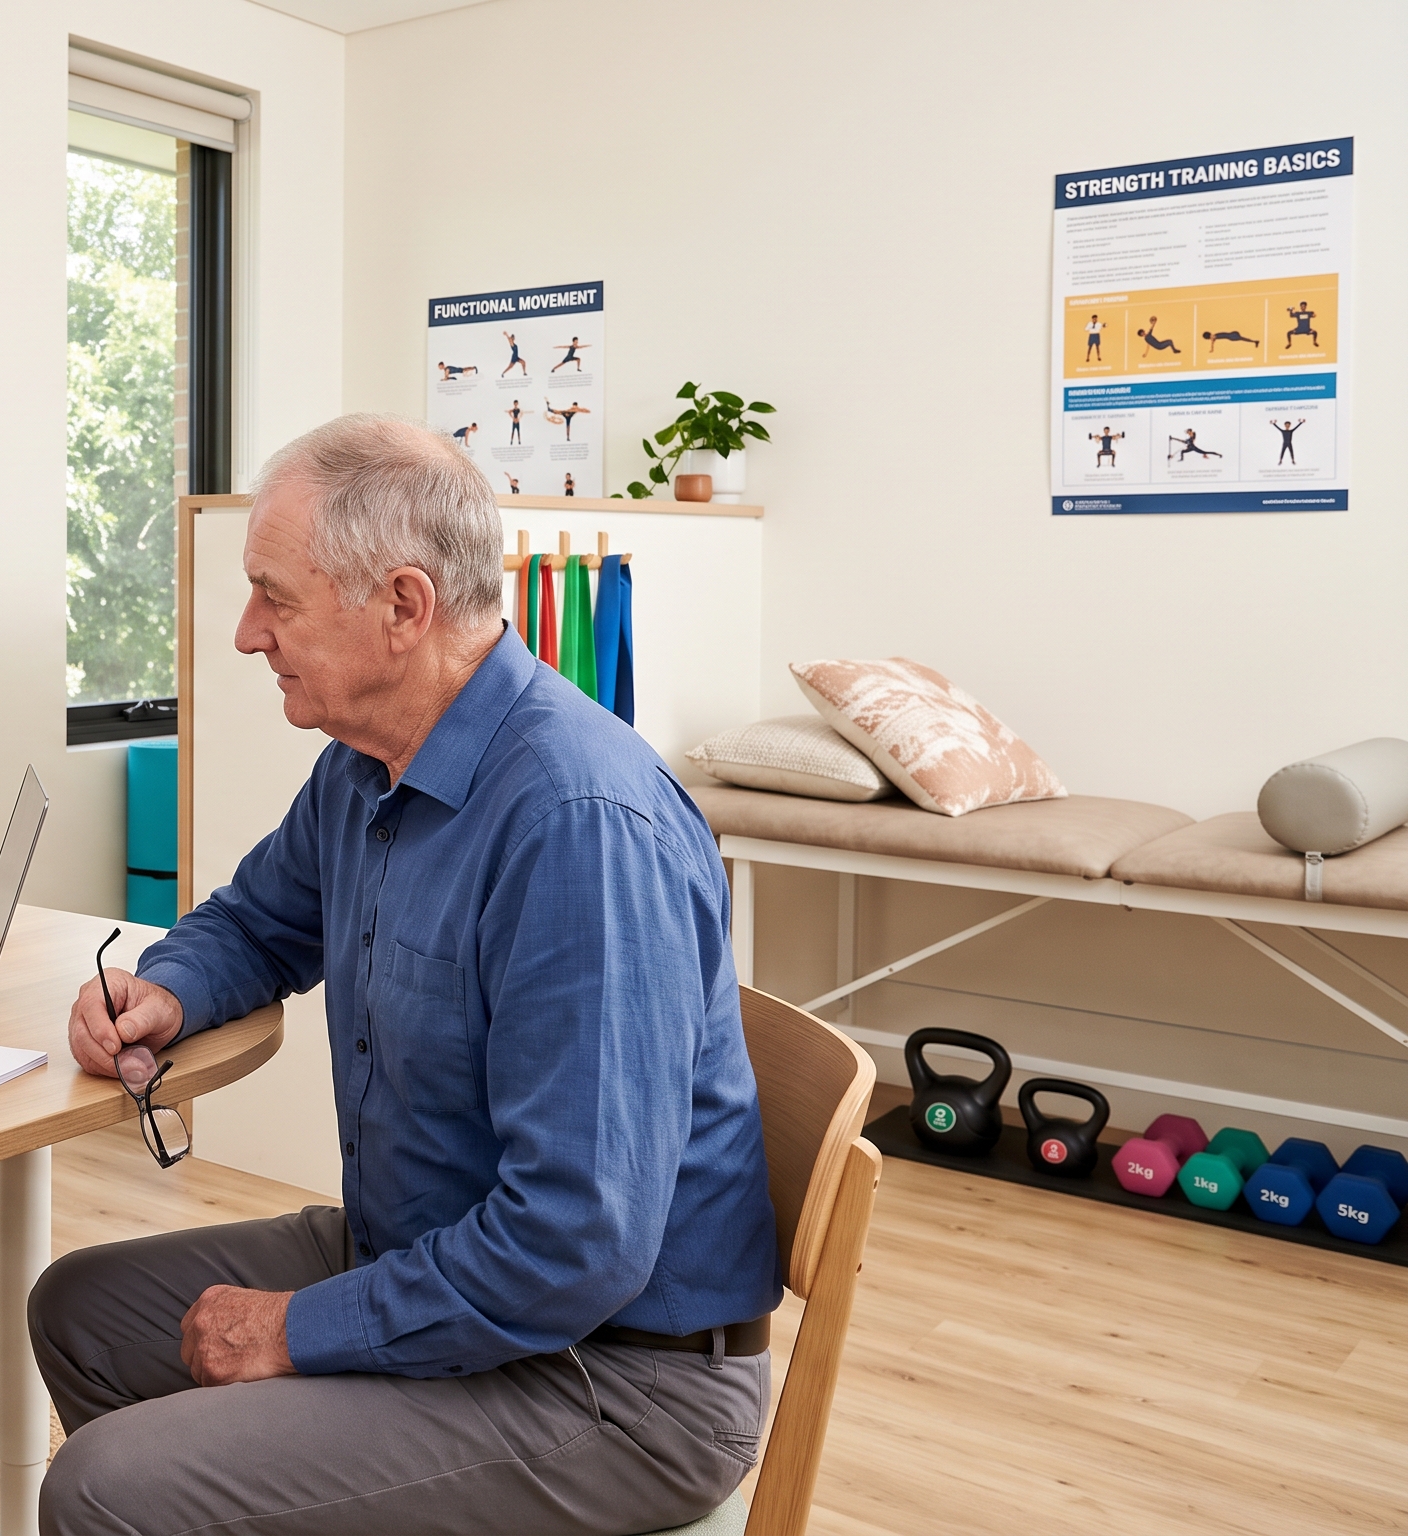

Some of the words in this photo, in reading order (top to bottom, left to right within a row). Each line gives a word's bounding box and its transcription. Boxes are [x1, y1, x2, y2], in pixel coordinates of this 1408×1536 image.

[1065, 171, 1165, 200] STRENGTH
[1168, 159, 1259, 187] TRAINNG
[1263, 148, 1341, 176] BASICS
[434, 297, 516, 319] FUNCTIONAL
[519, 289, 598, 311] MOVEMENT
[1127, 1161, 1154, 1180] 2kg
[1193, 1176, 1219, 1194] 1kg
[1260, 1189, 1290, 1208] 2kg
[1337, 1203, 1370, 1225] 5kg
